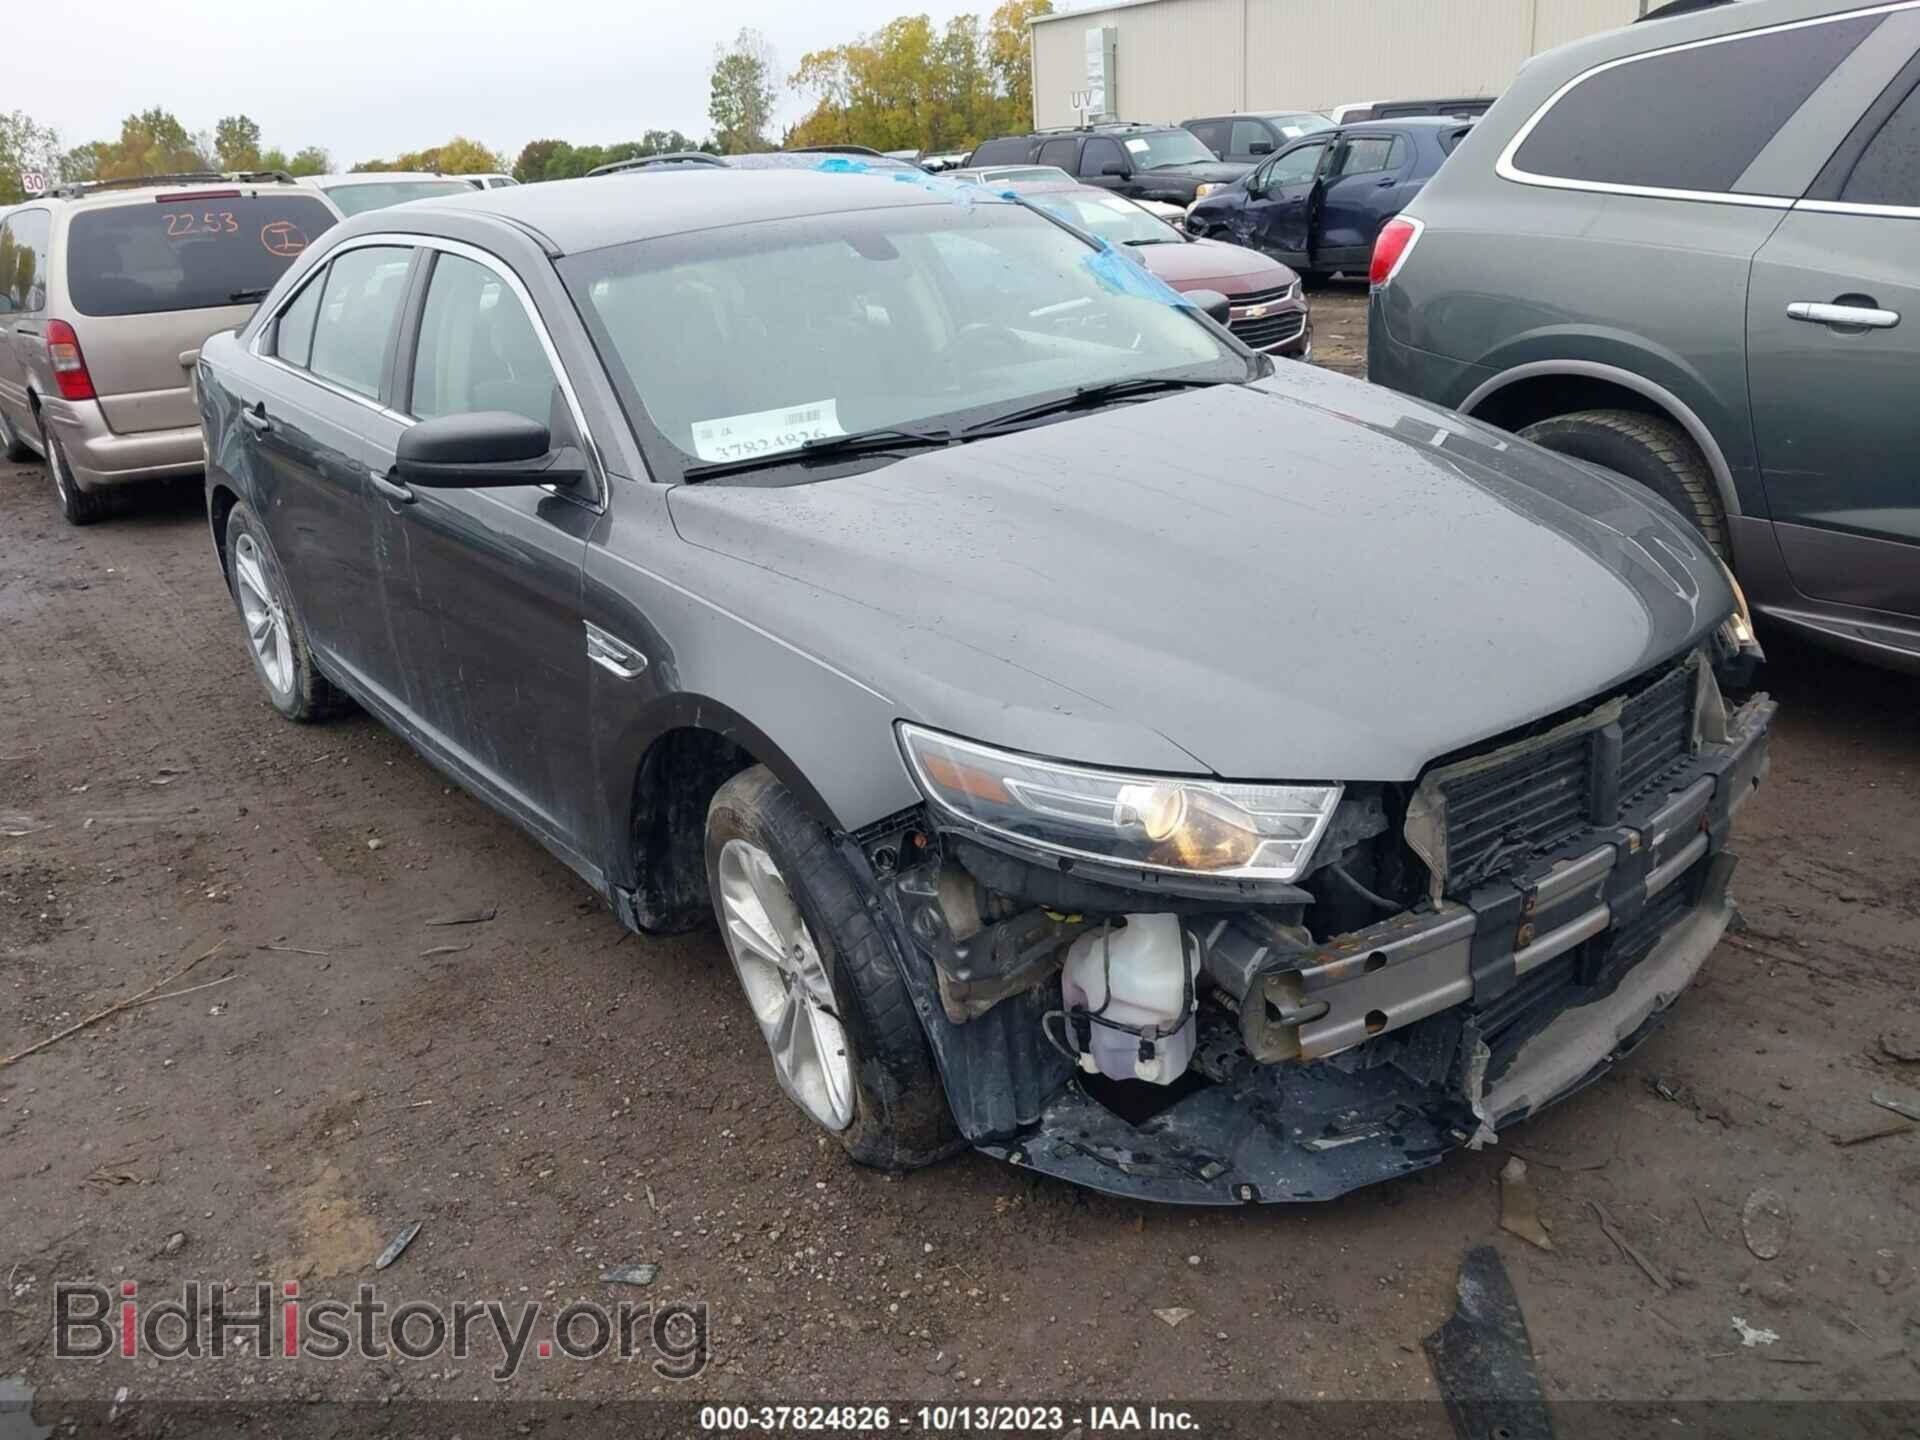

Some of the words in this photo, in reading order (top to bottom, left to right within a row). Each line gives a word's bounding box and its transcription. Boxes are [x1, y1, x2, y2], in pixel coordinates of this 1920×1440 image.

[1072, 89, 1092, 109] UV
[24, 175, 44, 190] 30
[163, 211, 240, 237] 2253
